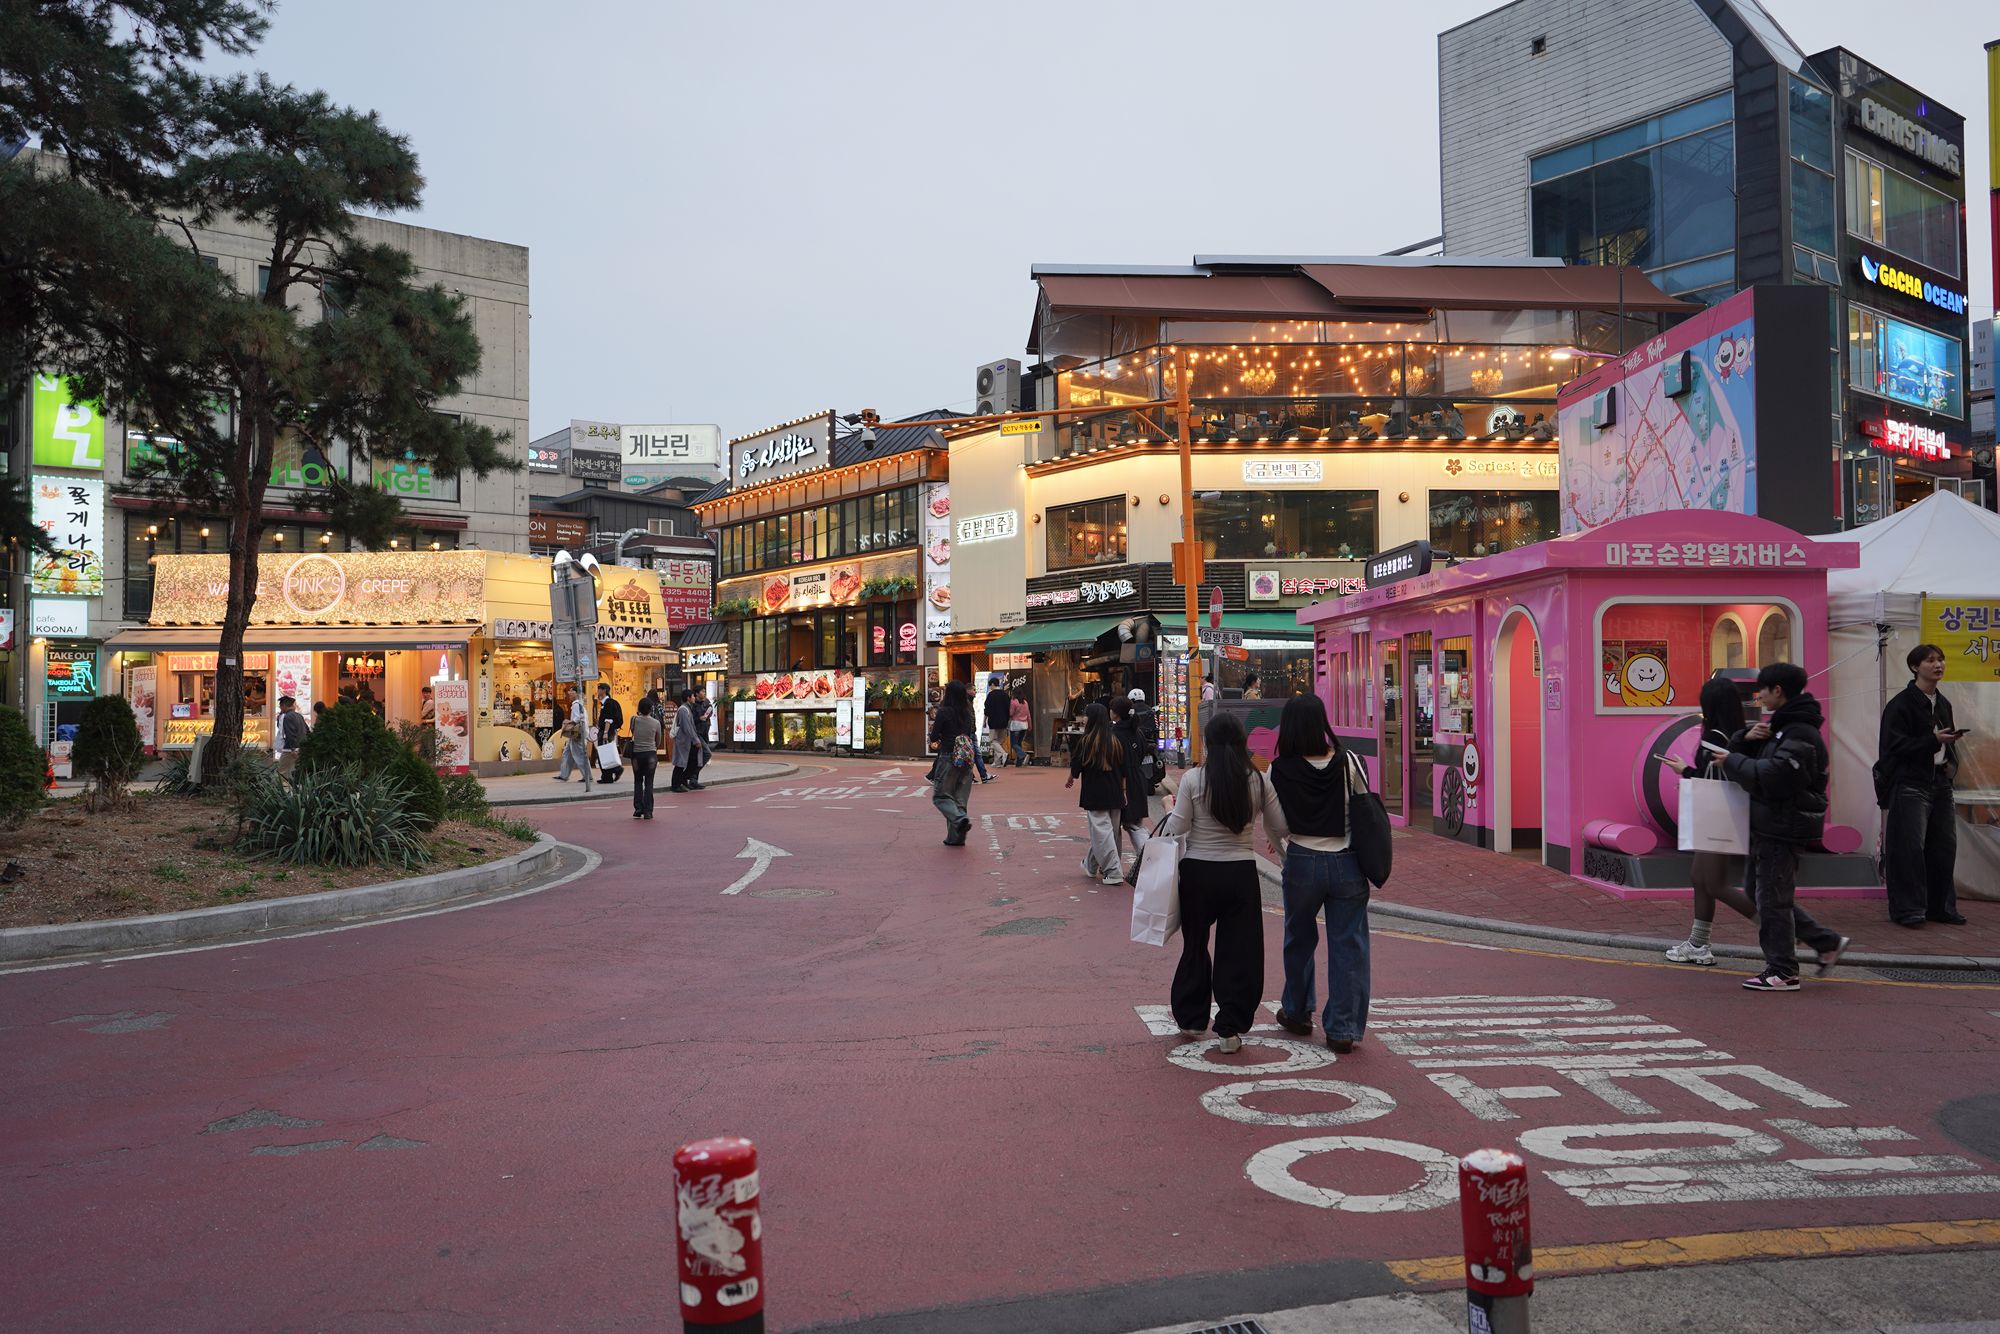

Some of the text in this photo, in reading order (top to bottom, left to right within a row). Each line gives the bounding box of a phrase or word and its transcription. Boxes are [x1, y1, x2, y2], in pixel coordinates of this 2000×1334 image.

[1861, 97, 1961, 177] CHRISTMAS
[1879, 263, 1963, 315] GACHA OCEAN
[629, 434, 689, 457] 게보린
[1256, 463, 1313, 477] 금별맥주
[1468, 460, 1516, 471] Series:
[40, 520, 55, 532] 2F
[66, 486, 92, 574] 꽃게나라
[963, 516, 1006, 539] 금별맥주
[1605, 543, 1806, 566] 마포순환열차버스
[669, 561, 707, 585] 부동산
[287, 576, 341, 593] PINK'S
[361, 579, 409, 593] CREPE
[36, 625, 78, 633] KOONA!
[1203, 632, 1241, 645] 일방통행
[48, 652, 96, 660] TAKE OUT
[169, 656, 202, 670] PINK'S
[278, 655, 310, 665] PINK'S
[437, 691, 466, 699] COFFEE
